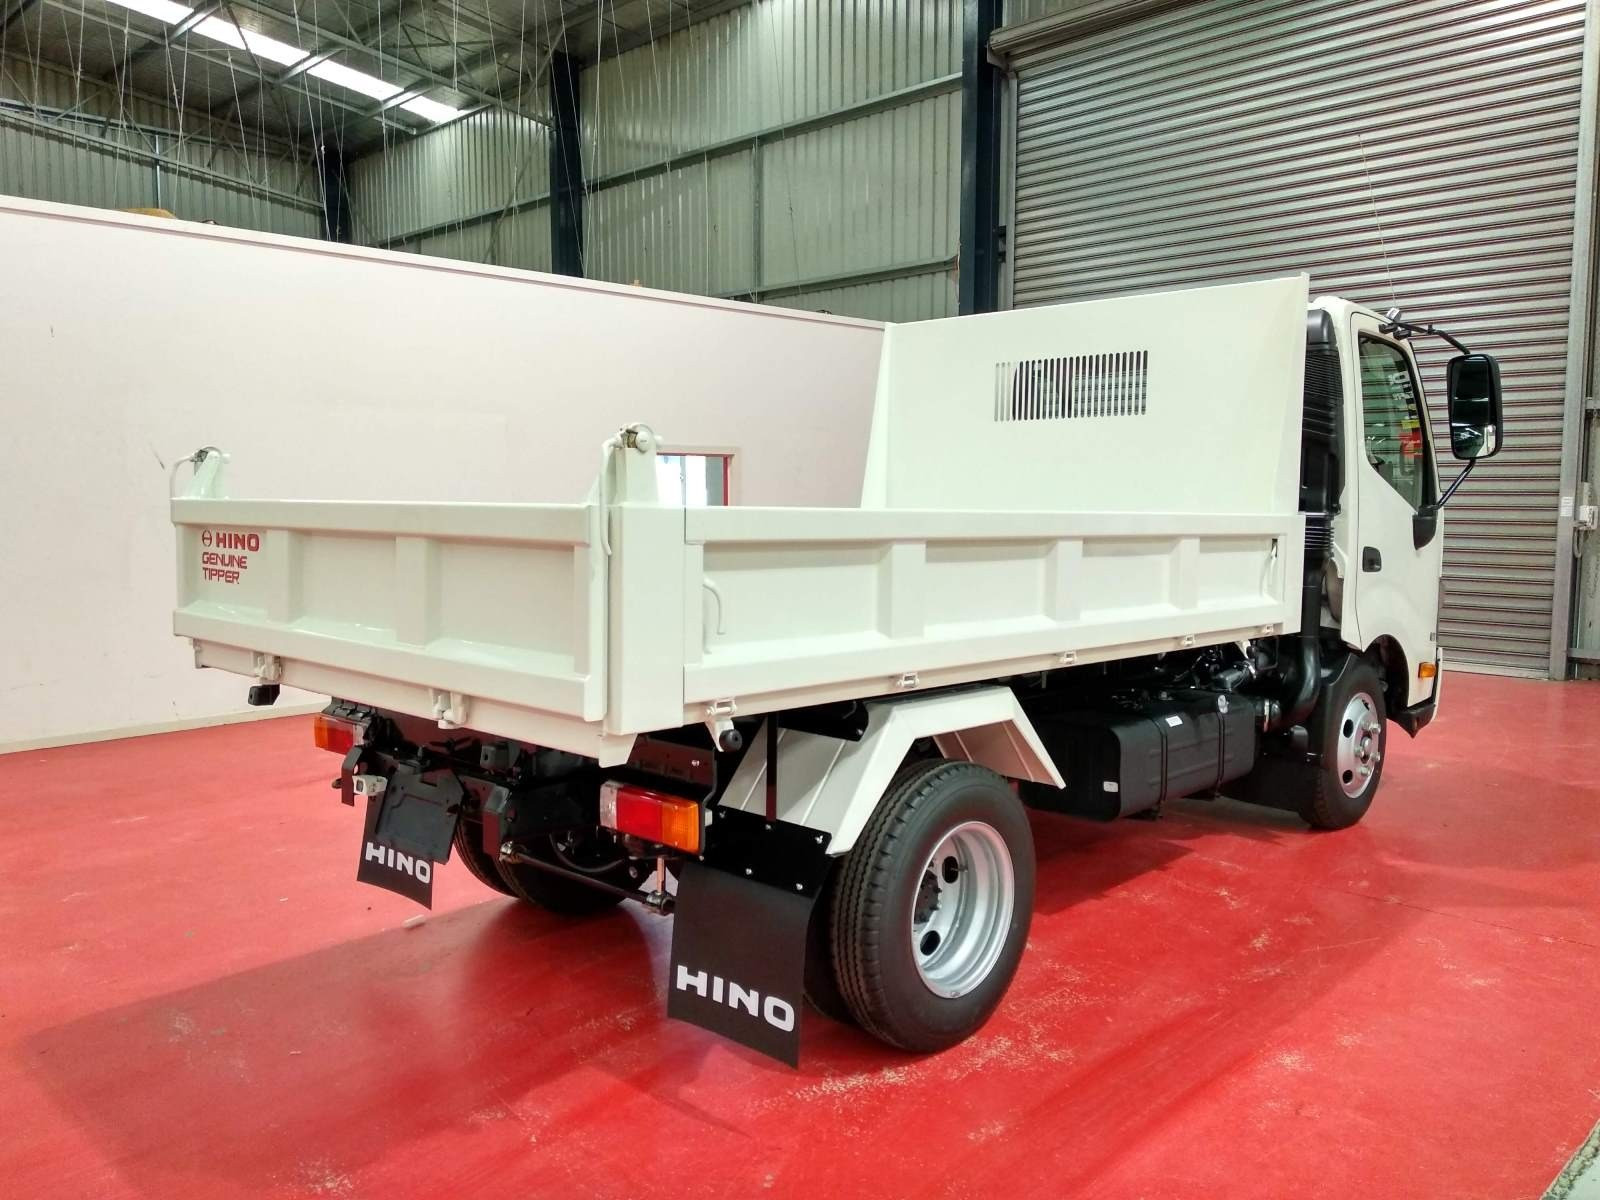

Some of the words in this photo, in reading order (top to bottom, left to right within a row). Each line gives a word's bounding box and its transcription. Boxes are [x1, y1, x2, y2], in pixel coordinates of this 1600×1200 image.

[216, 532, 260, 551] HINO
[202, 552, 248, 569] GENUINE
[202, 567, 240, 584] TIPPER
[365, 841, 431, 884] HINO
[676, 964, 795, 1032] HINO
